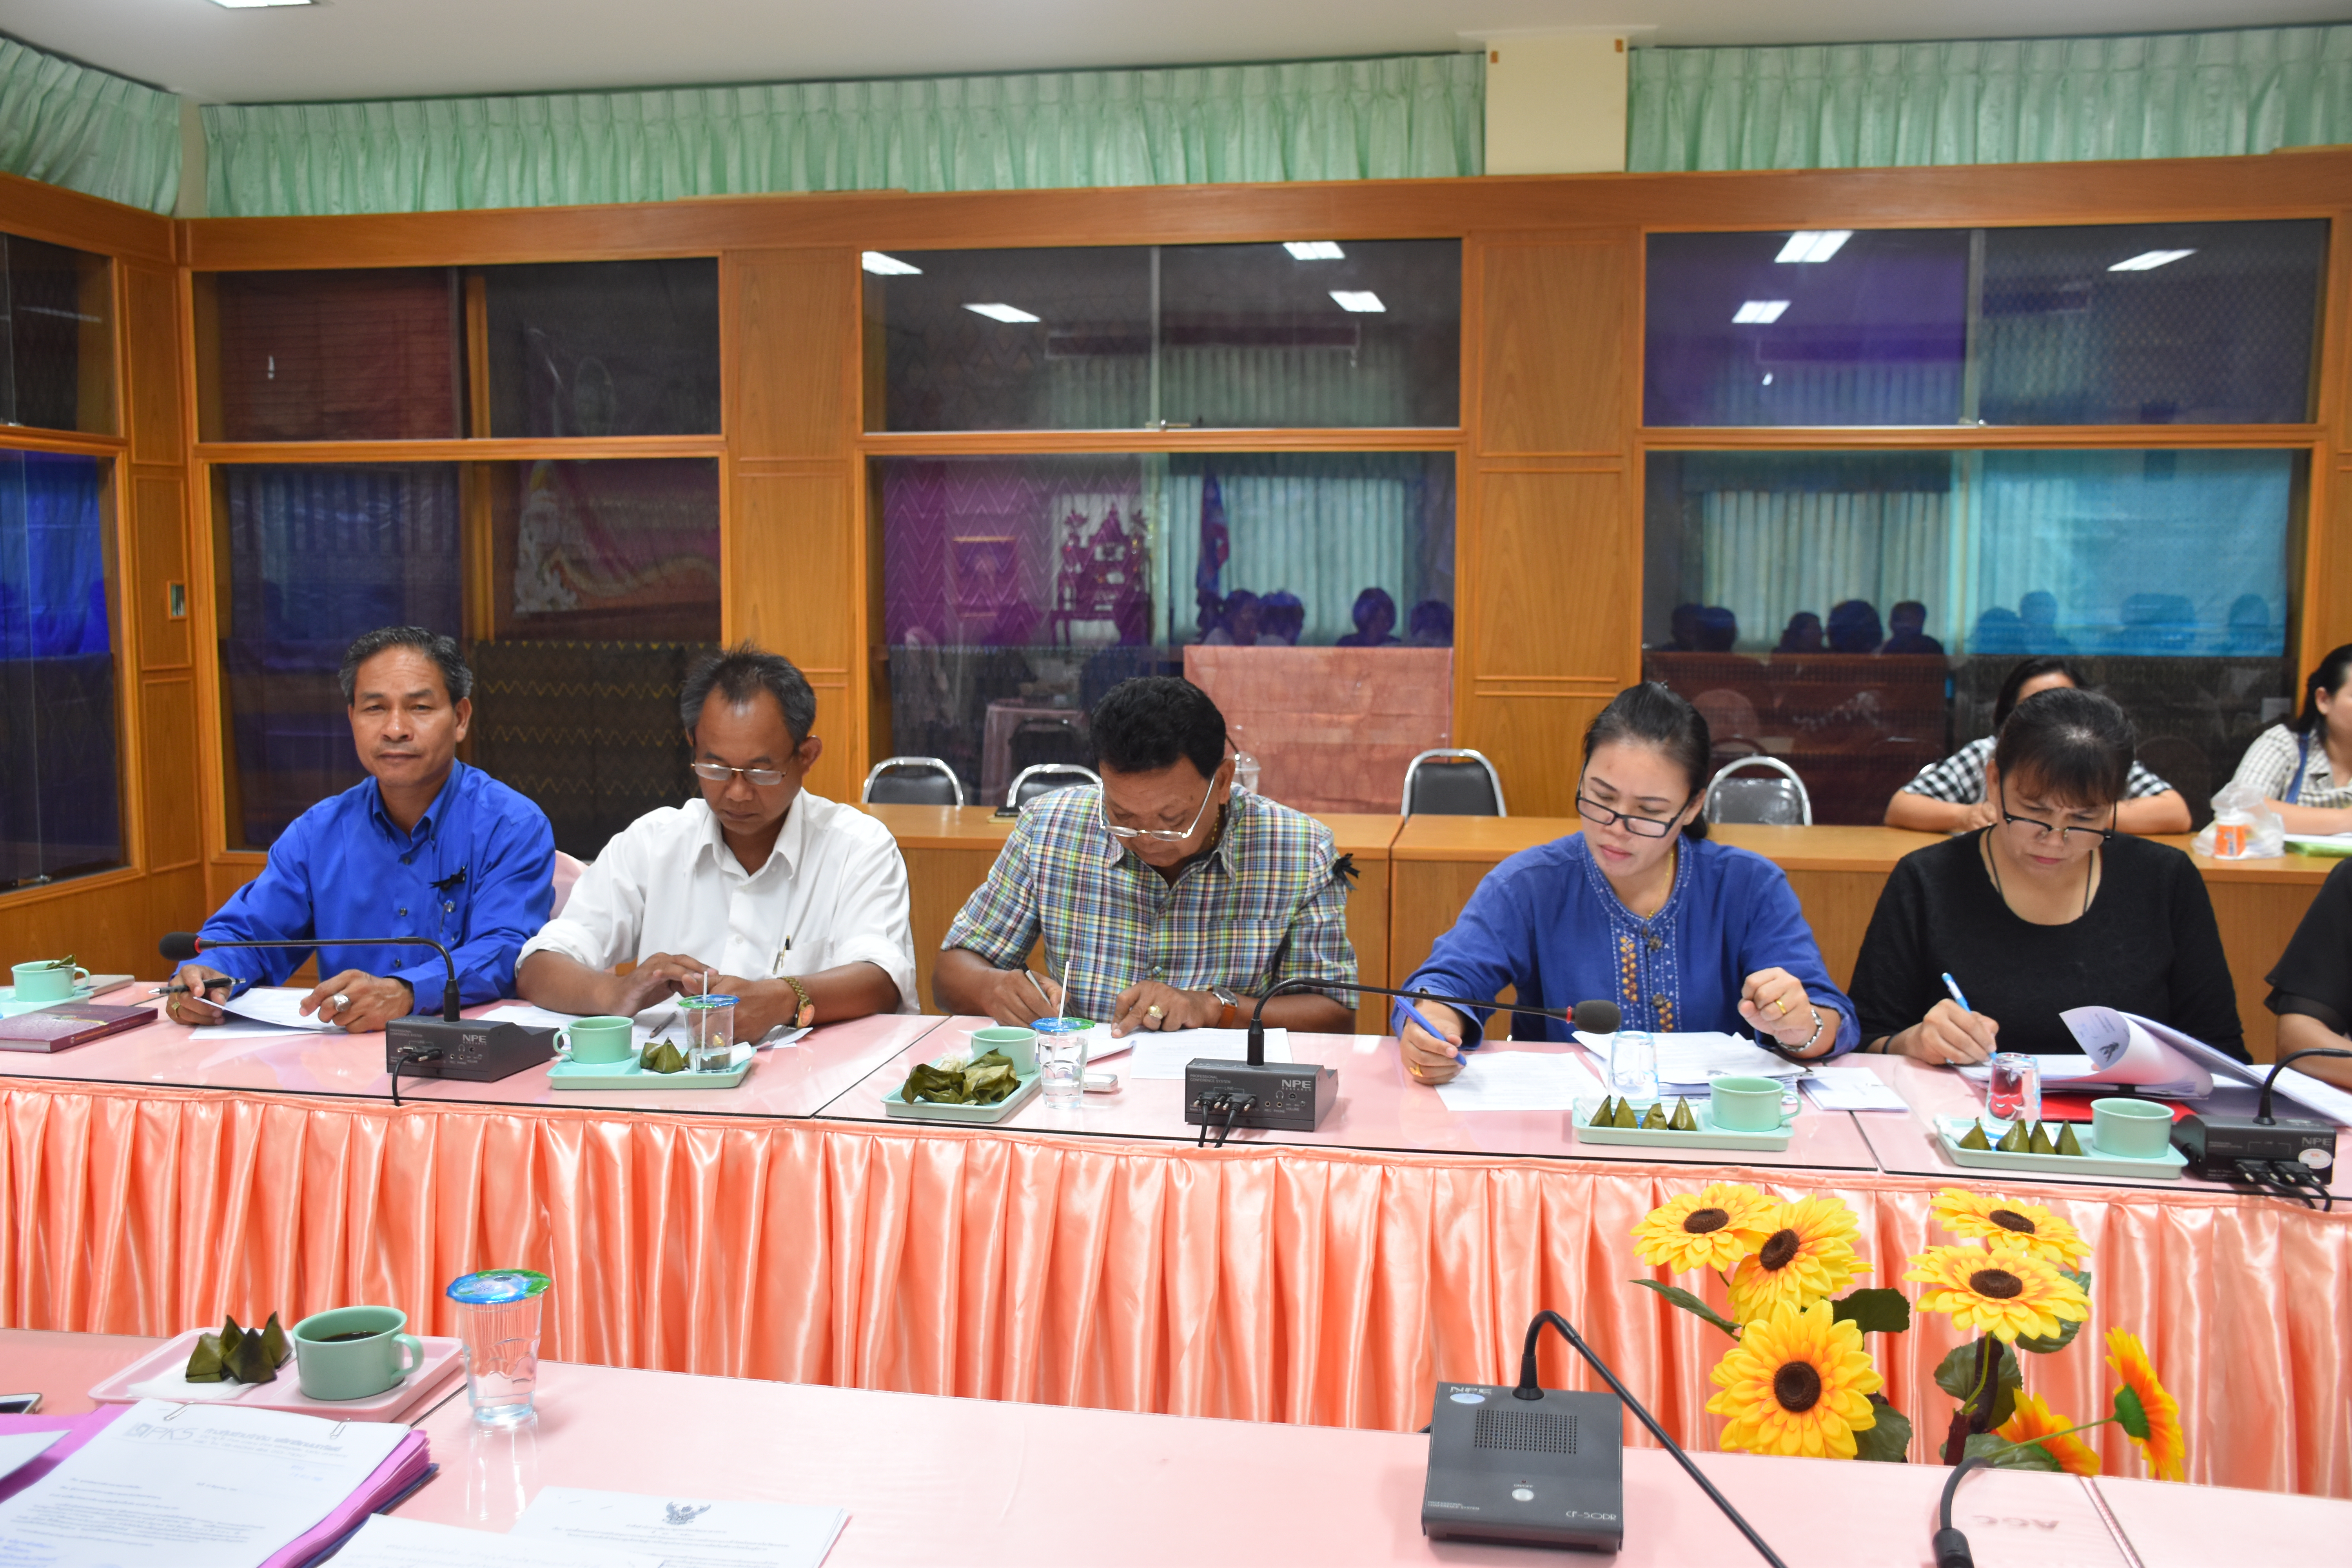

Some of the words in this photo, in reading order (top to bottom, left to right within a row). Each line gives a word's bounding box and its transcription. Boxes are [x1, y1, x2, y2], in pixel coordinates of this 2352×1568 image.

[463, 1034, 486, 1042] NPE
[1281, 1079, 1311, 1089] NPE
[2302, 1137, 2332, 1146] NPE
[144, 1427, 199, 1441] PKS
